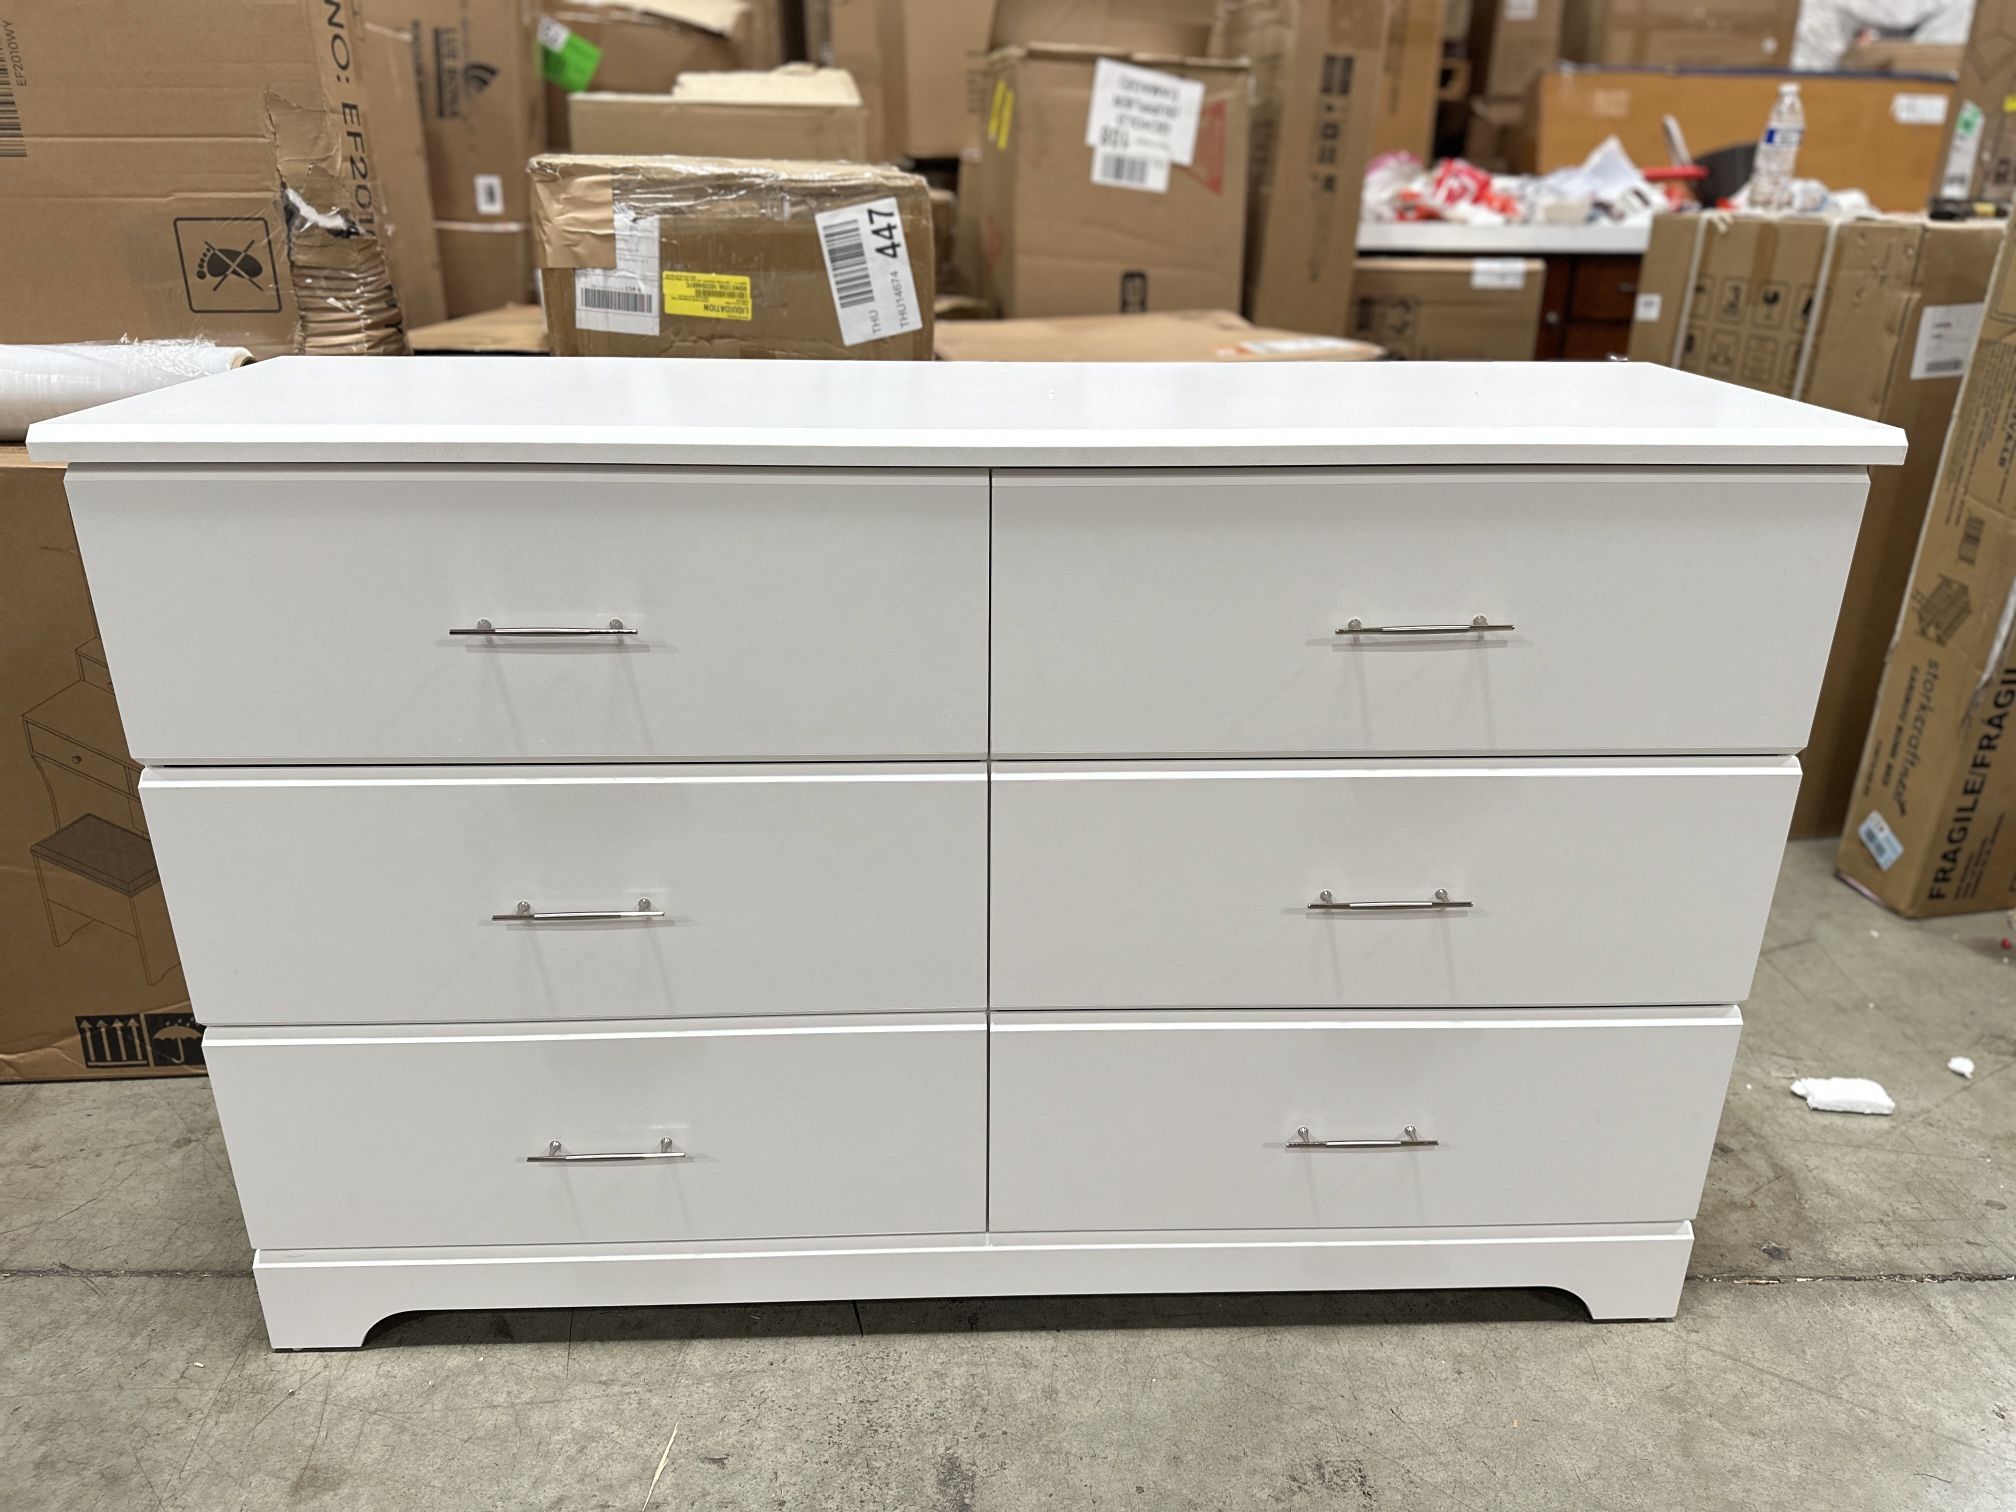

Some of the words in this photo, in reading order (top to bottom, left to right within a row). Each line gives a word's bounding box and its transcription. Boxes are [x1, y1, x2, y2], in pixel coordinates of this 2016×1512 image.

[1, 19, 28, 87] EF2010WY
[866, 208, 902, 259] 447
[703, 303, 750, 316] LIQUIDATION
[868, 309, 881, 334] THU
[889, 270, 909, 328] THU14674
